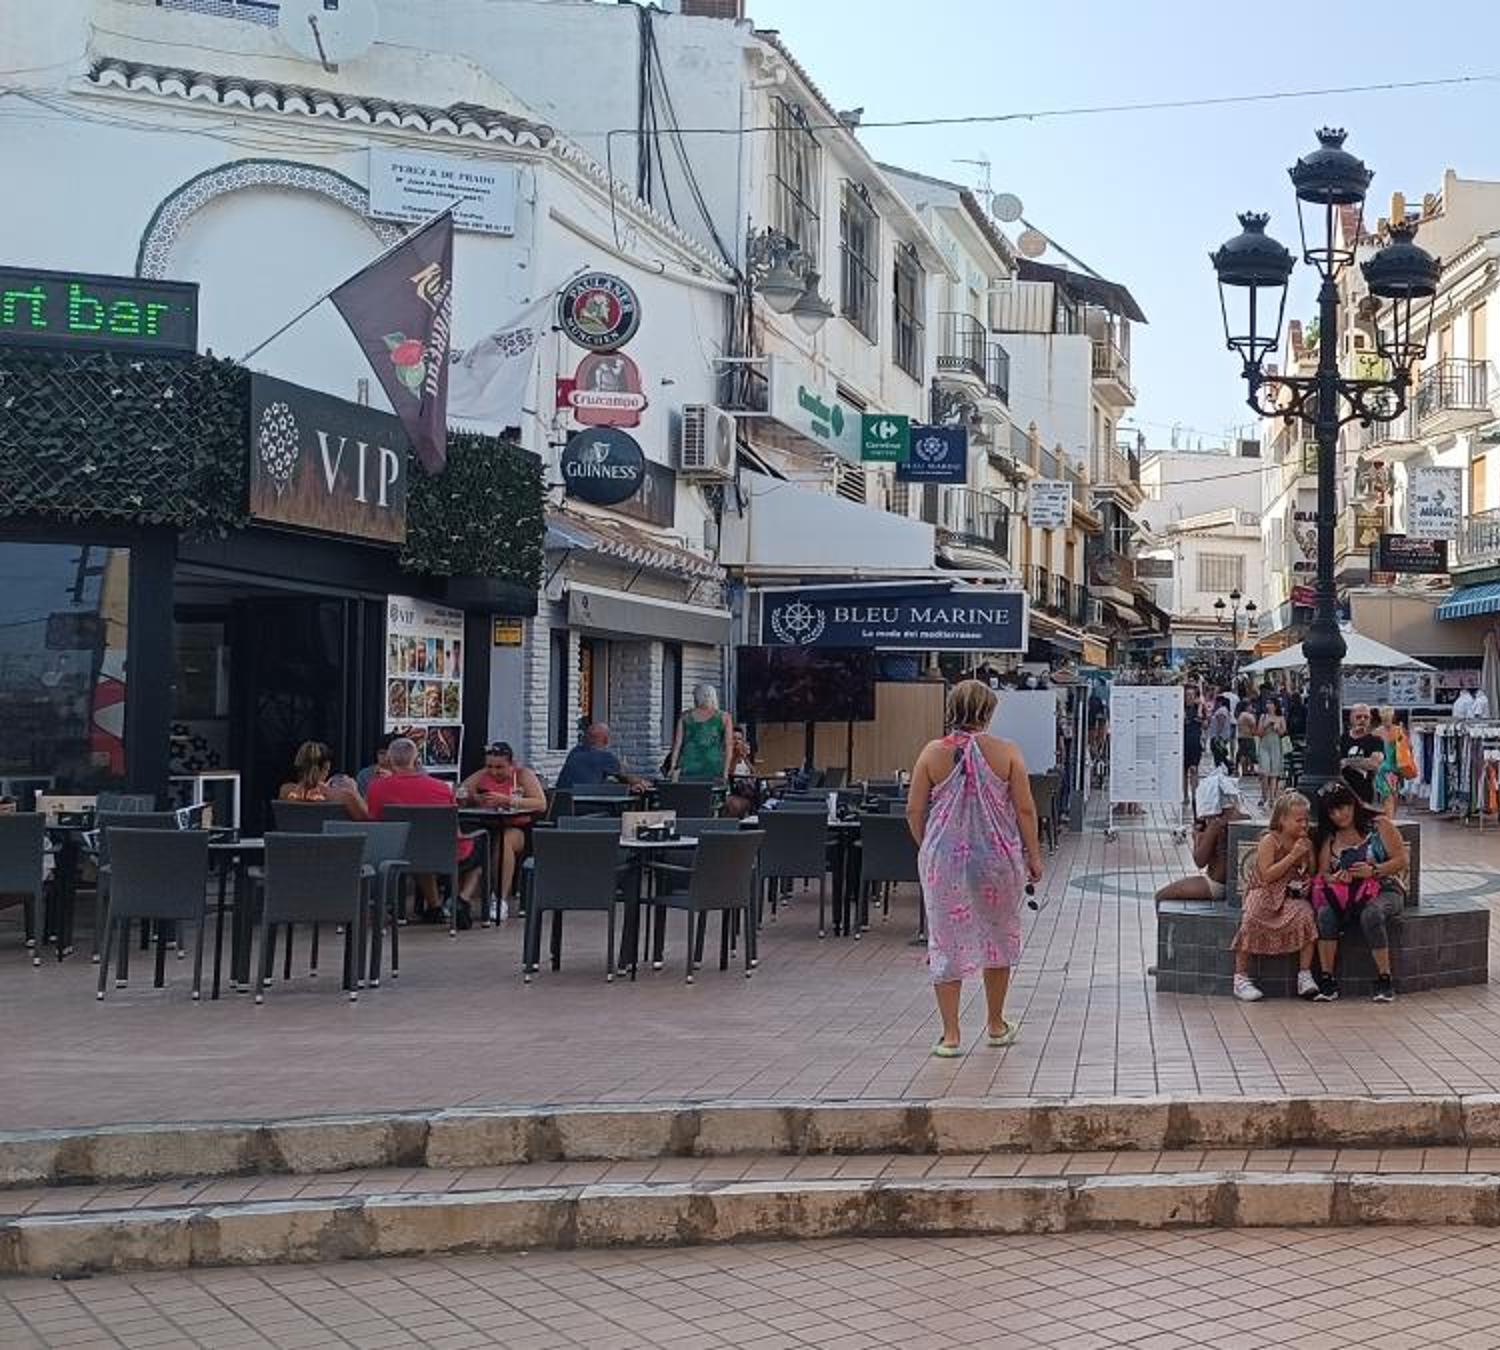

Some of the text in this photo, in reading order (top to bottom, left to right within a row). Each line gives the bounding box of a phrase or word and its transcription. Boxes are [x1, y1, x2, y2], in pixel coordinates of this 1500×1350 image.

[69, 284, 168, 335] bar
[573, 393, 639, 408] Cruzcampo
[317, 430, 399, 507] VIP
[567, 461, 637, 480] GUINNESS
[834, 607, 1010, 625] BLEU MARINE
